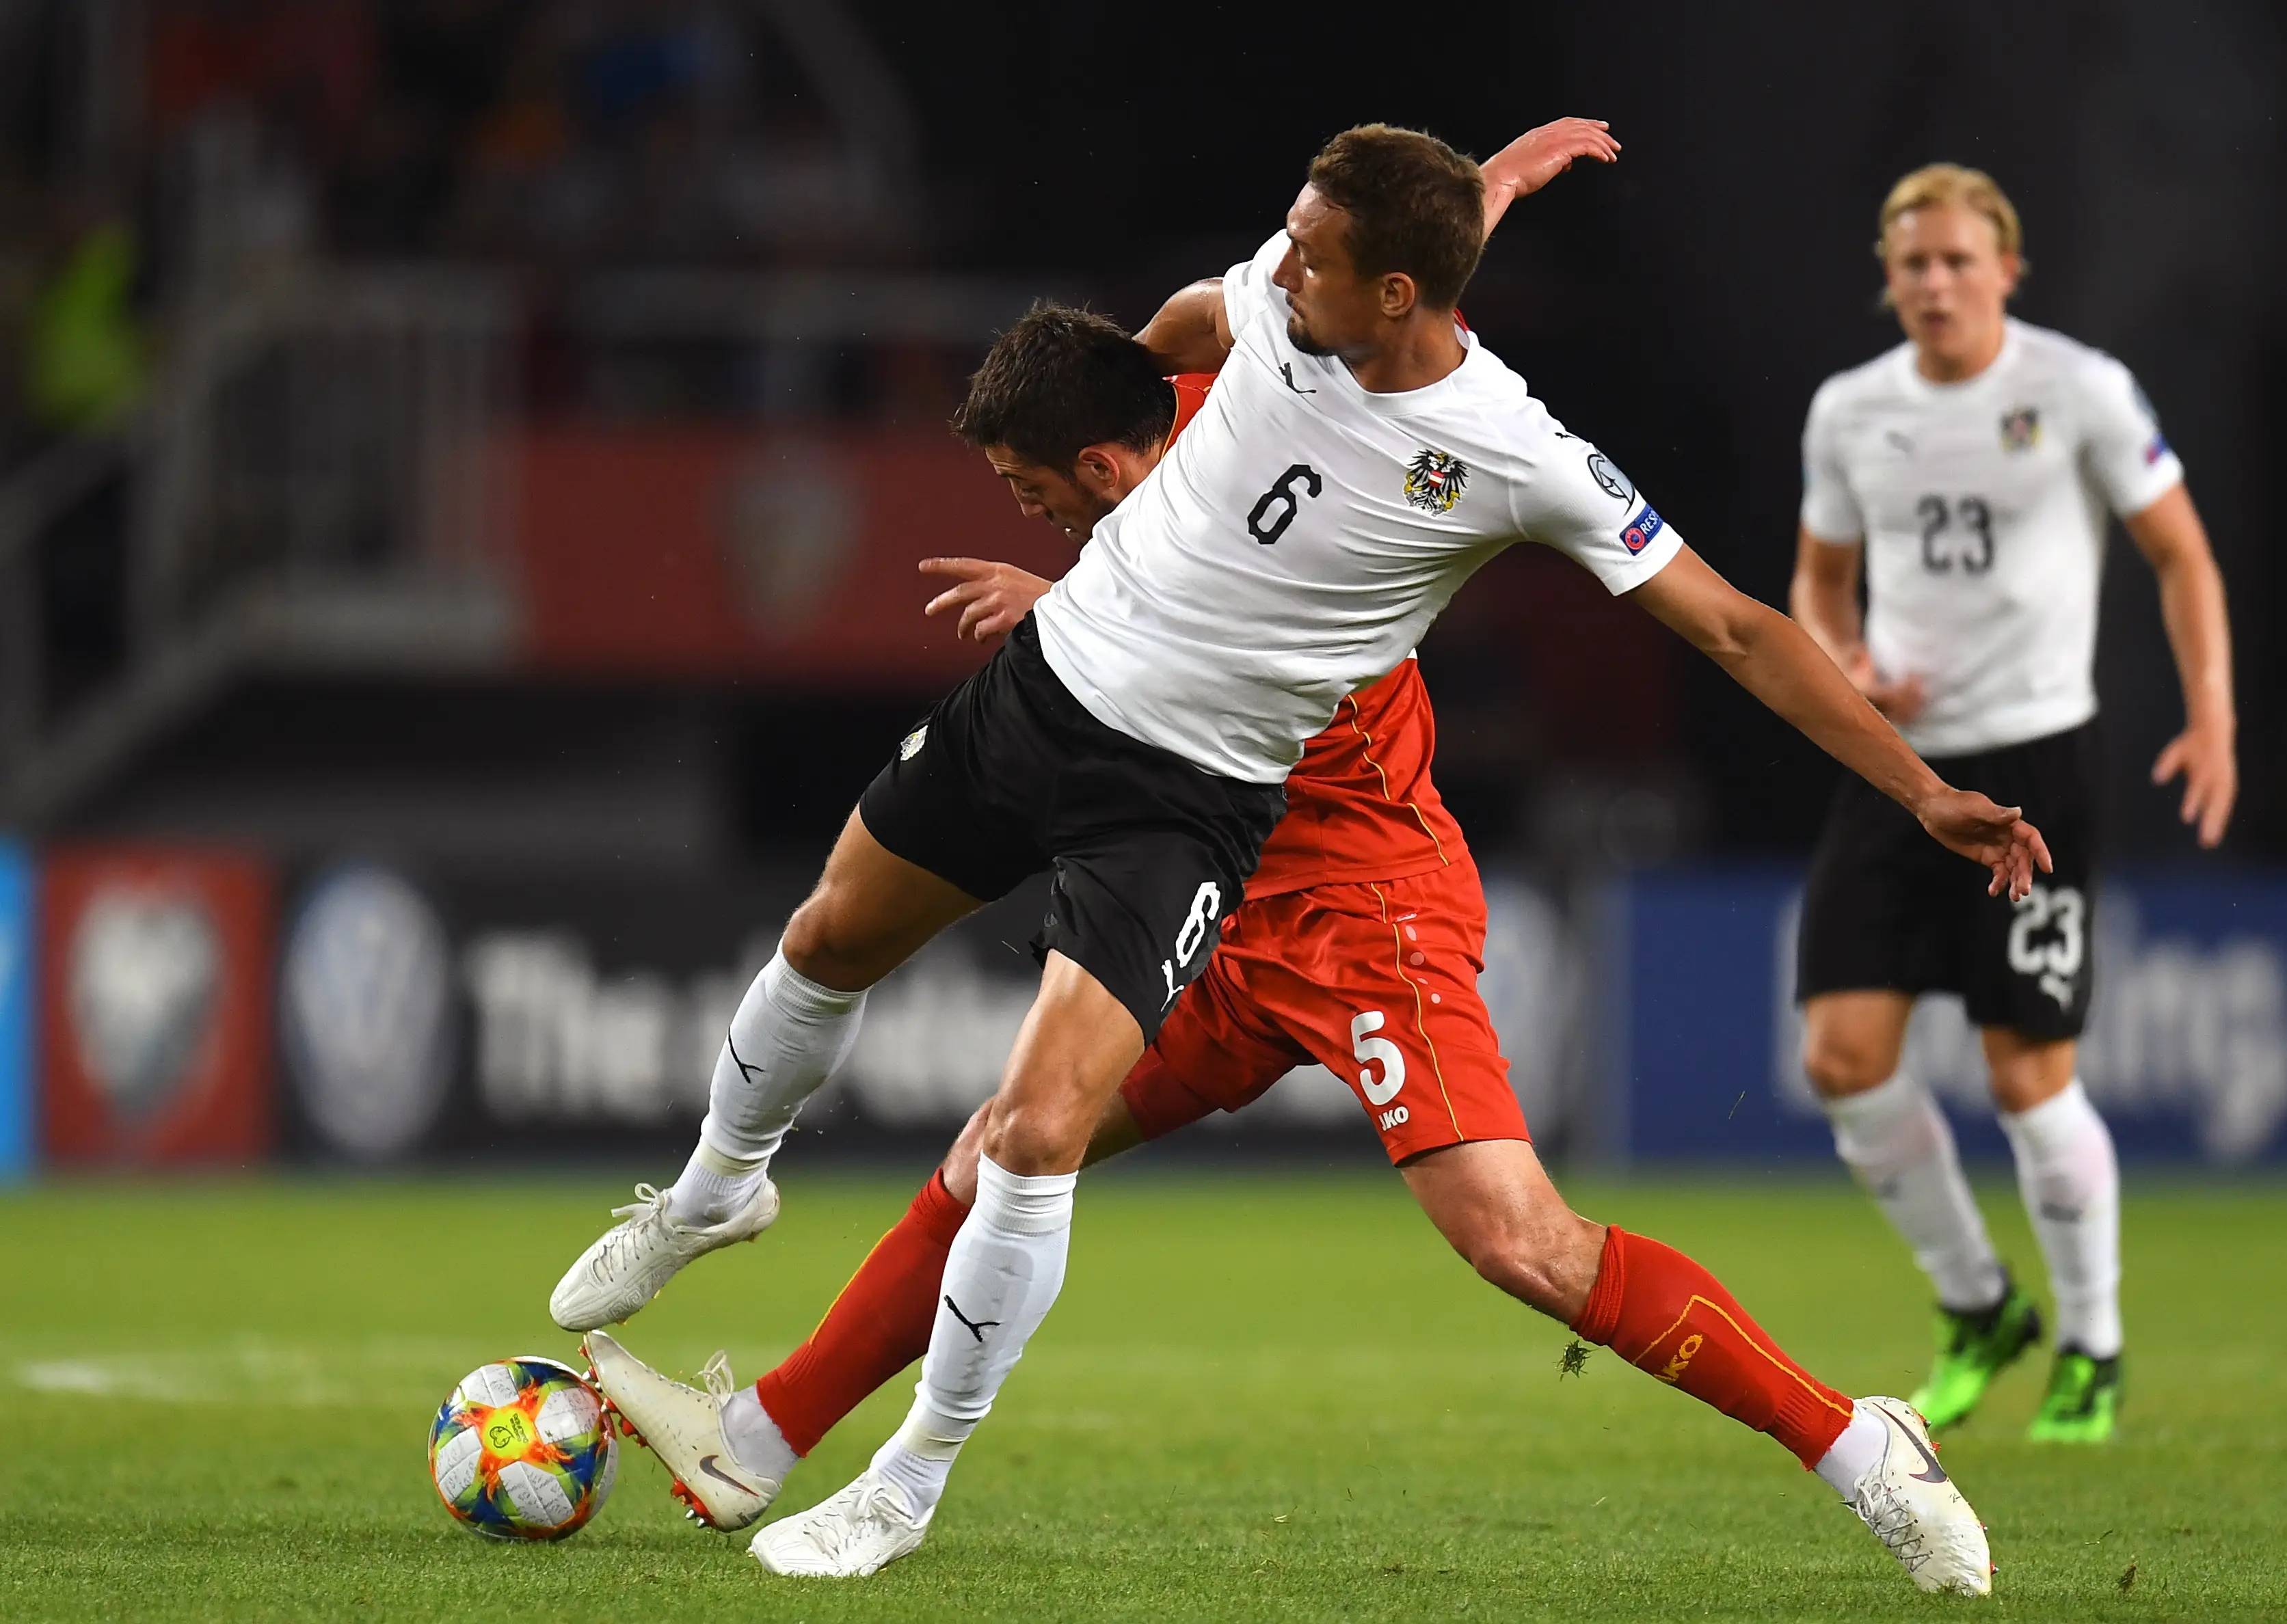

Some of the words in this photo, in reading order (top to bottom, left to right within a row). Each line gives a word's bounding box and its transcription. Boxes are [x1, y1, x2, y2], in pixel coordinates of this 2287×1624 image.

[1247, 464, 1322, 545] 6
[1916, 494, 1994, 576] 23
[1175, 881, 1221, 968] 6
[2009, 885, 2083, 975] 23
[1350, 1010, 1406, 1105] 5
